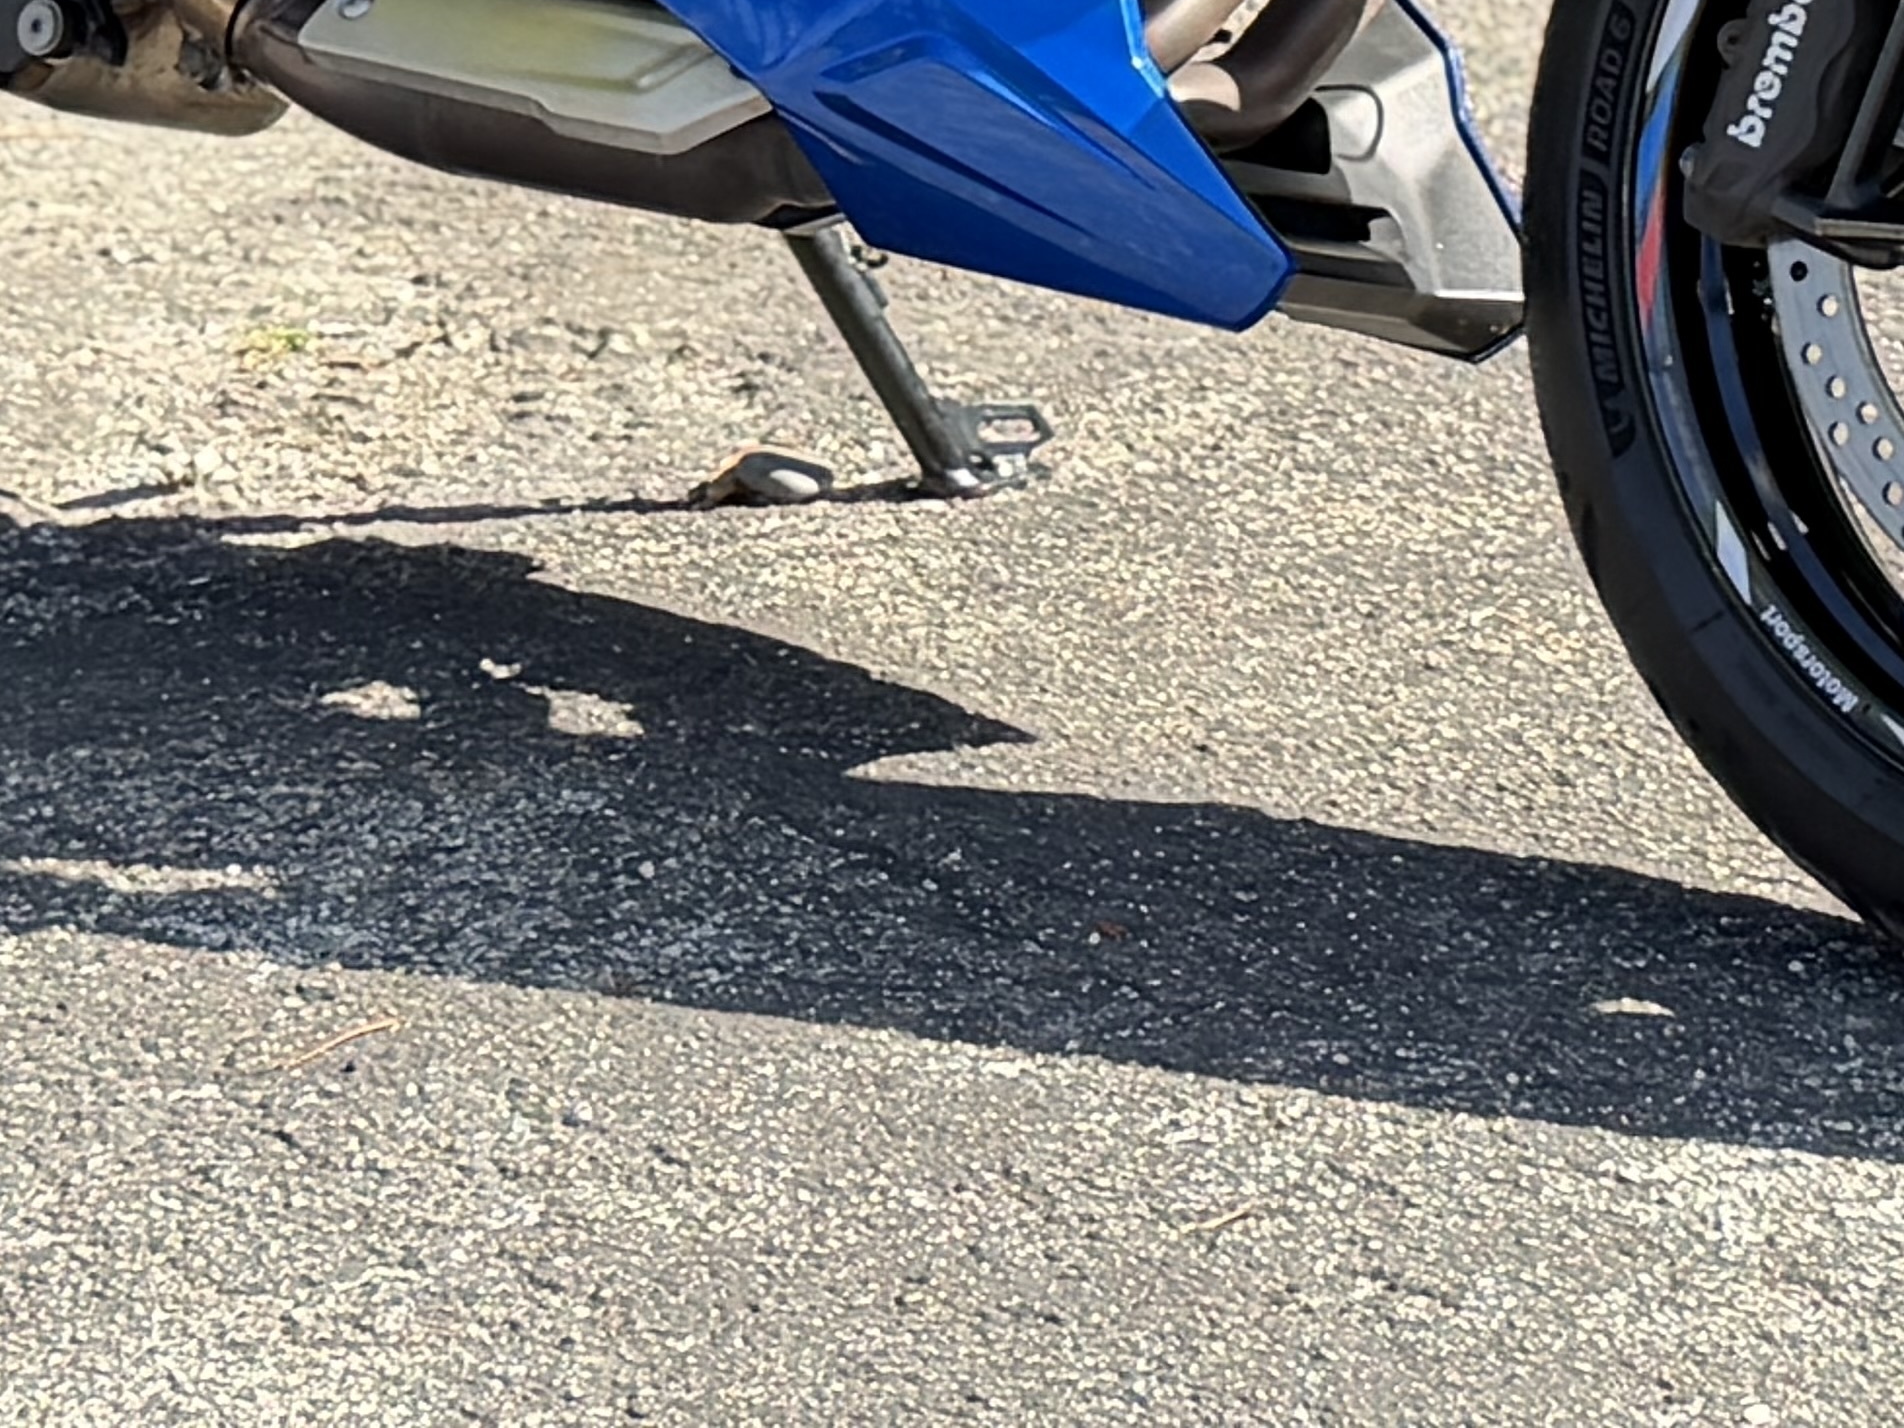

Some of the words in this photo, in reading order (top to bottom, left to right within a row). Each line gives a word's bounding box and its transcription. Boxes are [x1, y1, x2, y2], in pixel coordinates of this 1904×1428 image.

[1611, 9, 1634, 39] 6
[1586, 50, 1624, 152] ROAD
[1580, 187, 1624, 385] MICHELIN
[1760, 604, 1859, 714] Motorsport
